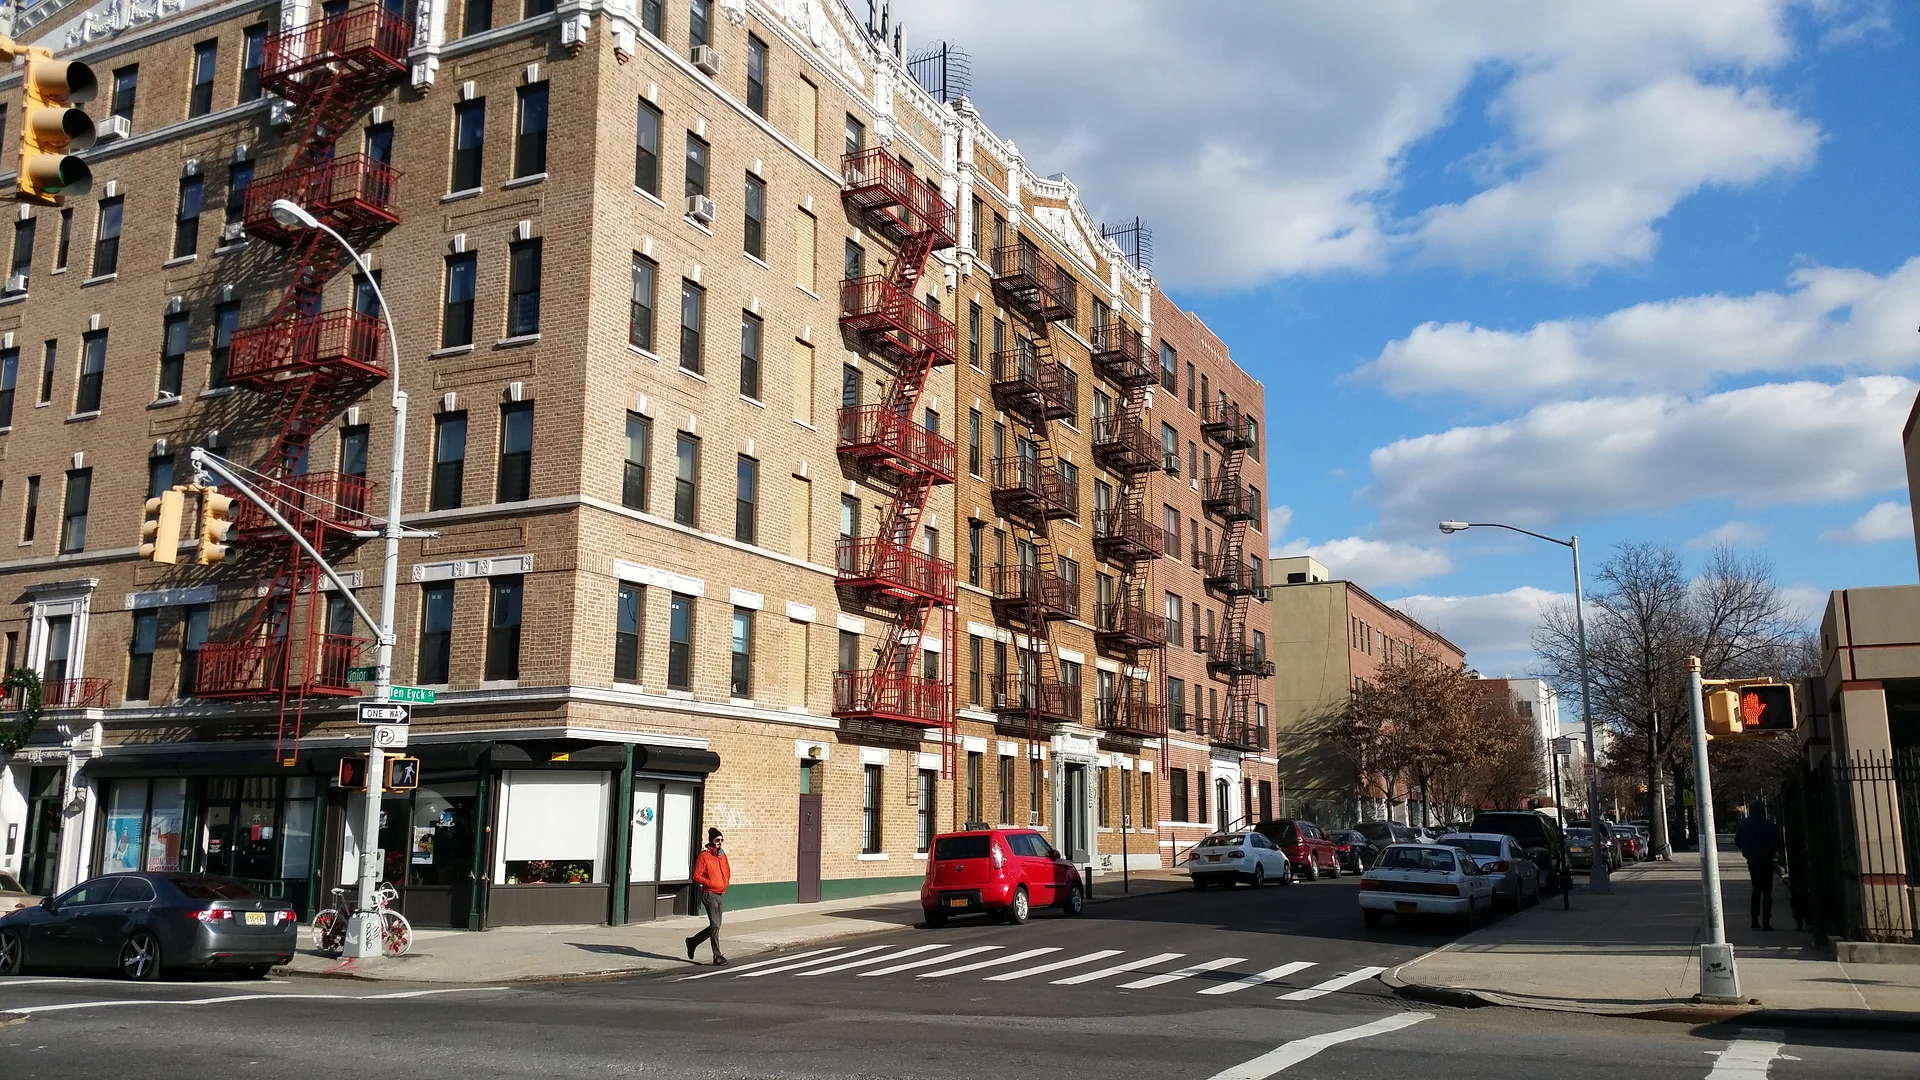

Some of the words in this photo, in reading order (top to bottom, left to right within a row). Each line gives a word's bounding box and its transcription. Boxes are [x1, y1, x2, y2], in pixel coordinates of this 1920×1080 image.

[347, 668, 368, 682] Union
[390, 687, 404, 698] Ten
[407, 689, 425, 701] Eyck
[367, 709, 383, 718] ONE
[389, 710, 404, 718] WAY
